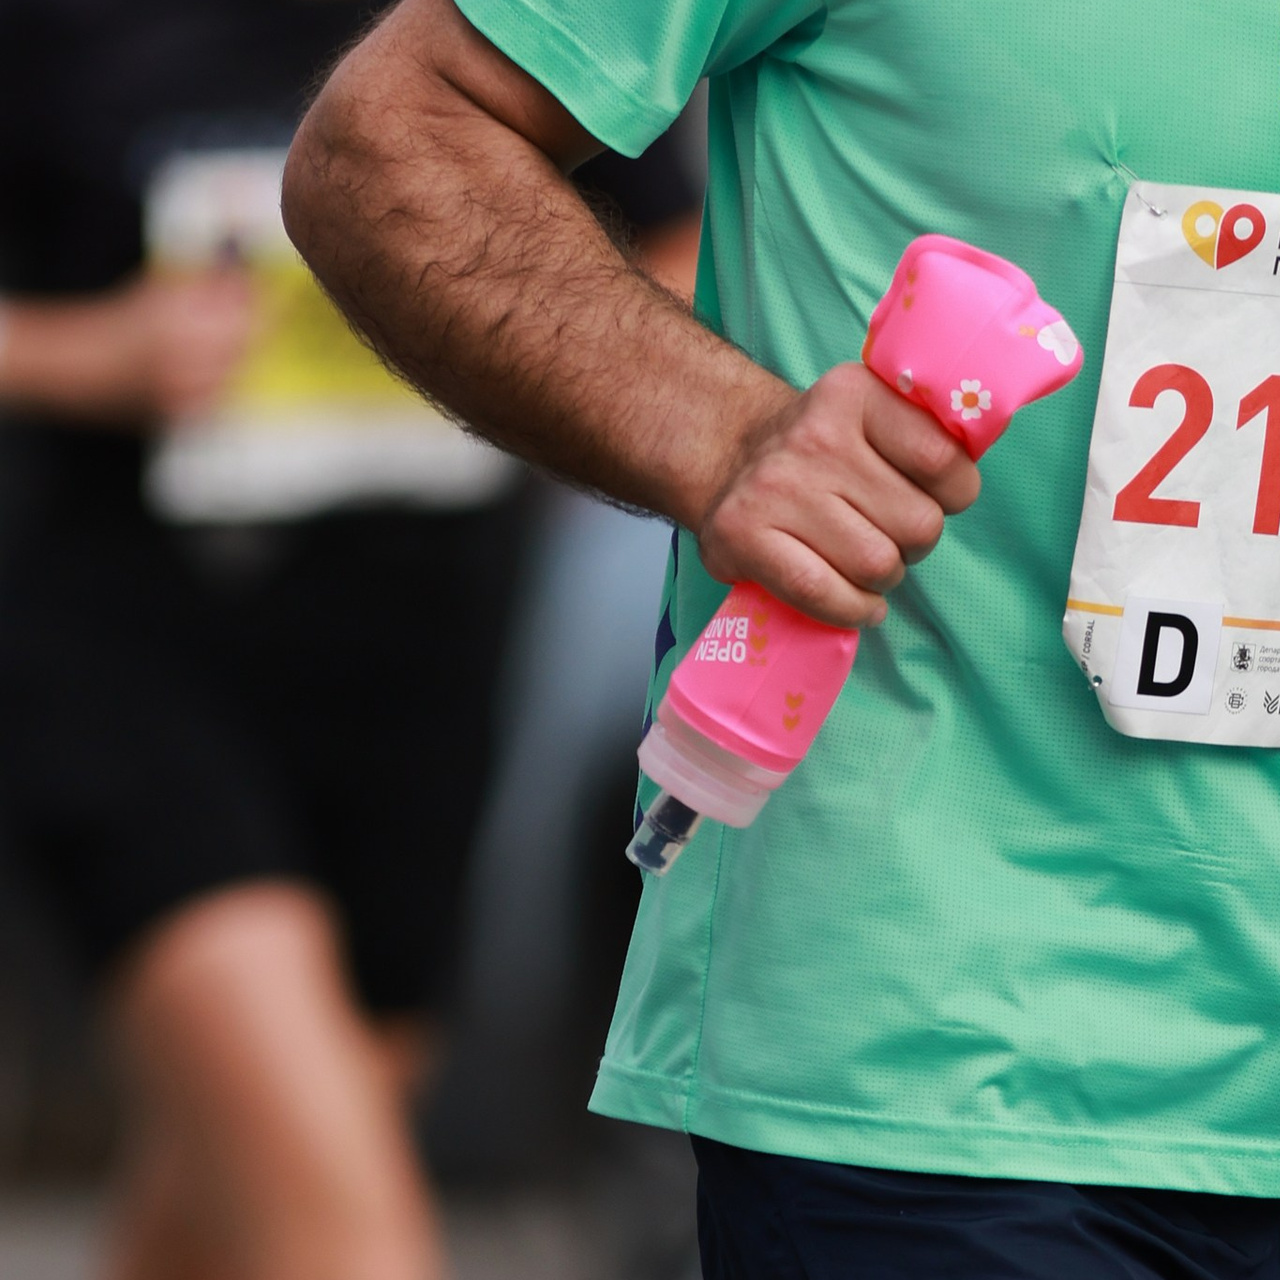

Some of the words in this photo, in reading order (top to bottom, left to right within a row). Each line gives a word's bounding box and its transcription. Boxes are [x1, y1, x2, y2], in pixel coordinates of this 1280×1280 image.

[695, 640, 747, 664] OPEN
[1082, 619, 1096, 654] CORRAL
[1136, 610, 1200, 698] D
